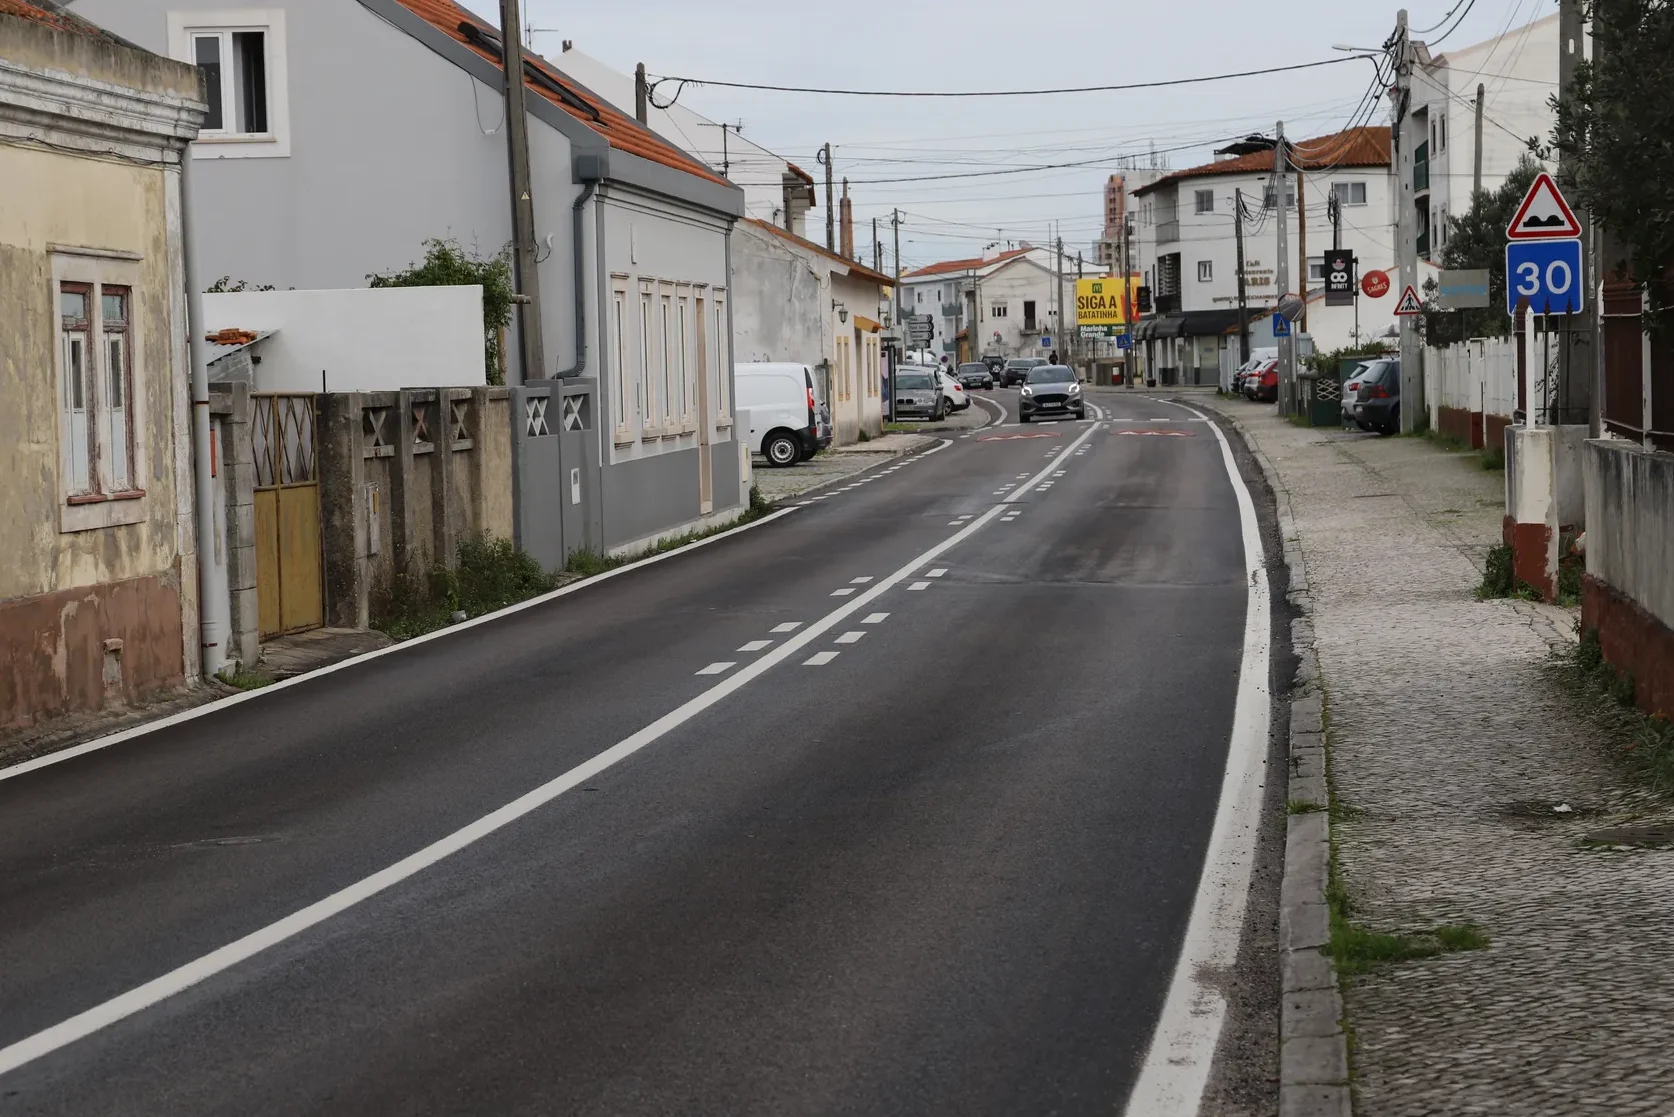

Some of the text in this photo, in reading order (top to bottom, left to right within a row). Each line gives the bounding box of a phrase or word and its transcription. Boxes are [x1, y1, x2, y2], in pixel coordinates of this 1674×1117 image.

[1516, 260, 1572, 296] 30
[1367, 281, 1388, 294] SAGRES
[1078, 295, 1117, 309] SIGA A
[1078, 310, 1117, 319] BATATINHA
